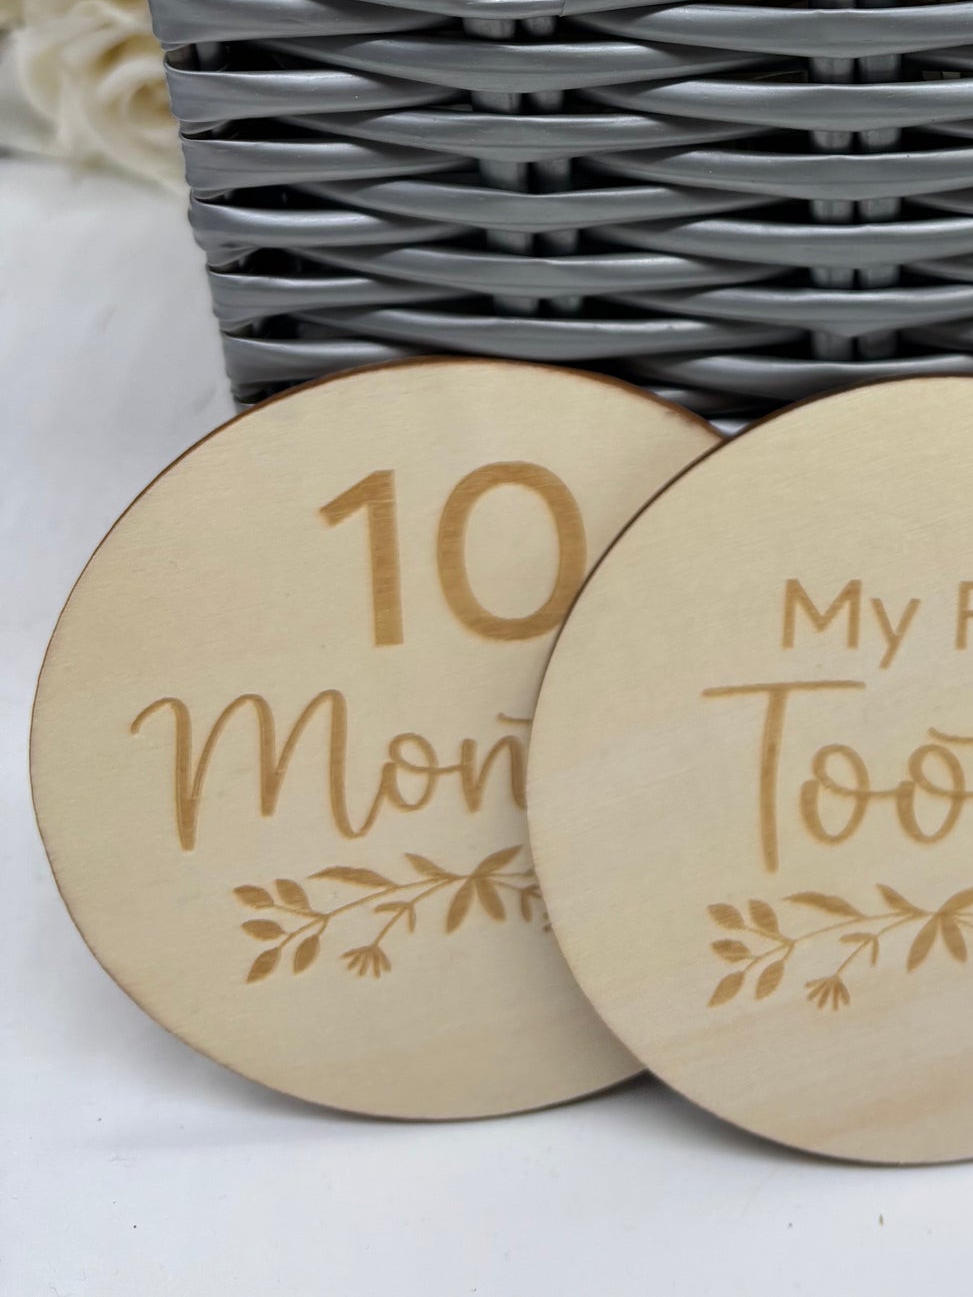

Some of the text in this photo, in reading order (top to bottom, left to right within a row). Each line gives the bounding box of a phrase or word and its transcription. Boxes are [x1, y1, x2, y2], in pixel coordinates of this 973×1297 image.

[318, 460, 589, 649] 10
[781, 577, 922, 670] My
[130, 688, 533, 852] Mon
